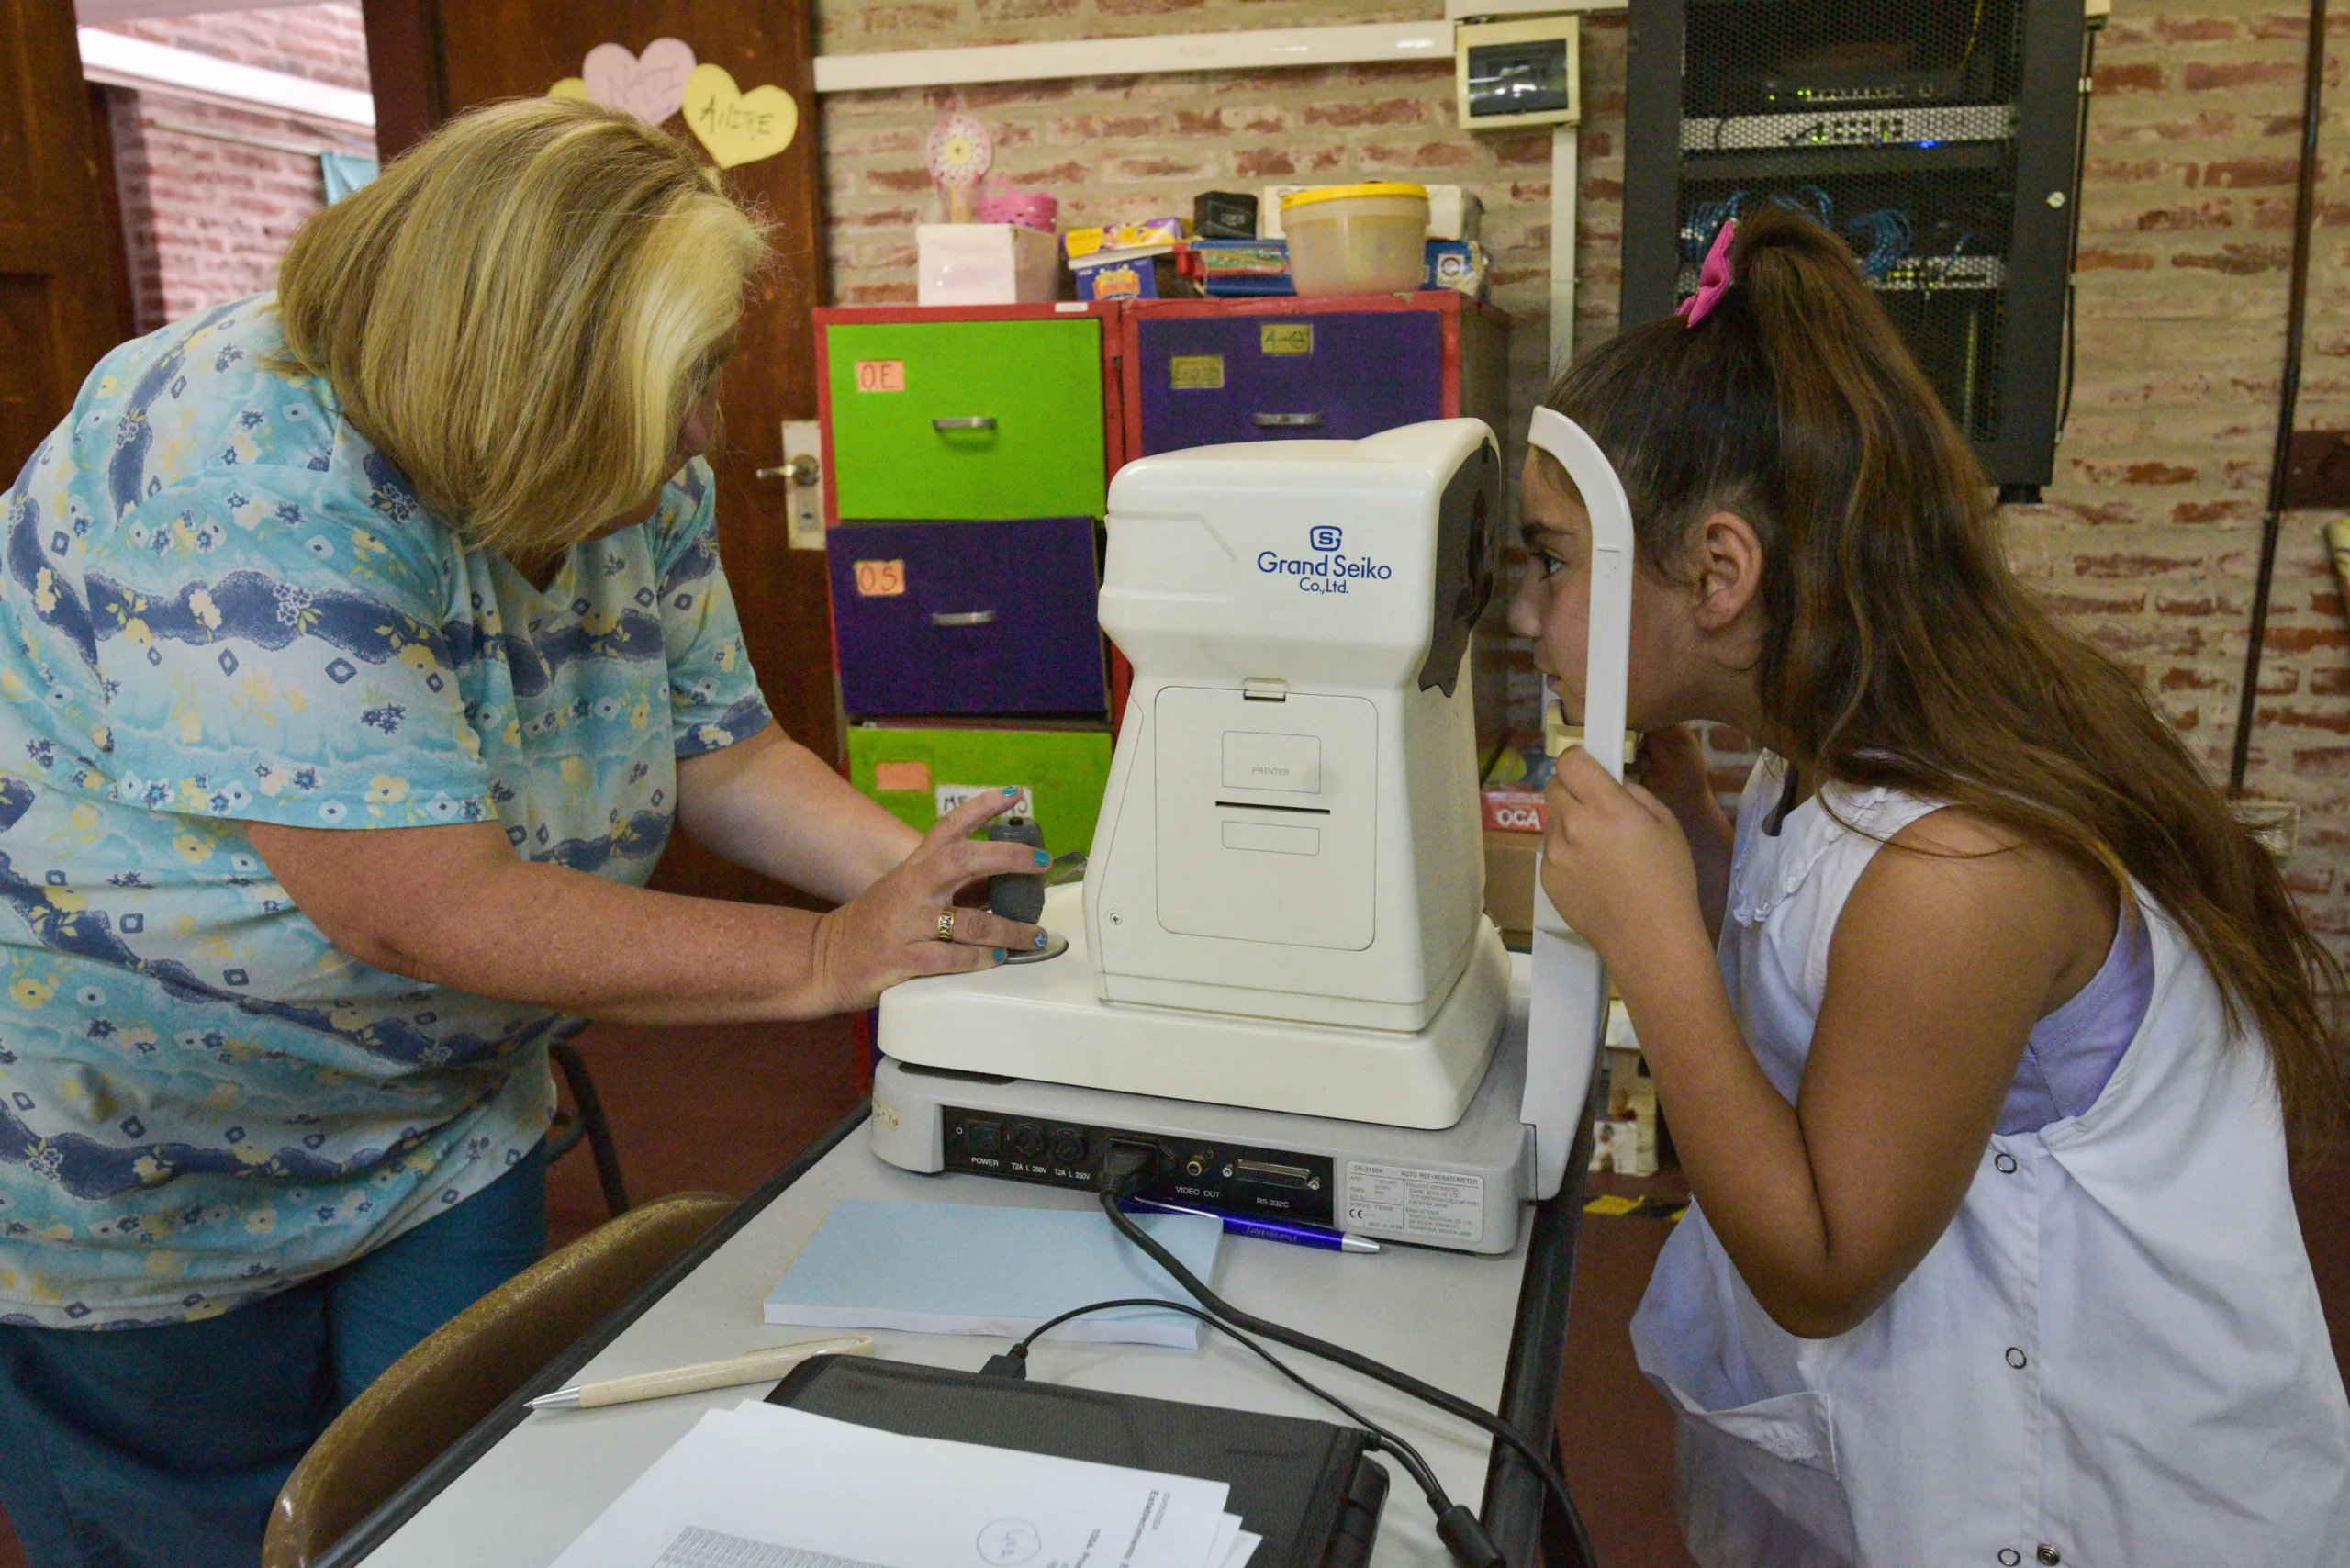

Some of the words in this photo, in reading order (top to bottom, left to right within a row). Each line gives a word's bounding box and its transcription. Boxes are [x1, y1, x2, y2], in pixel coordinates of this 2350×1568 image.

[1257, 551, 1329, 577] Grand
[1332, 554, 1393, 580] Seiko
[1251, 767, 1290, 777] PRINTER
[971, 1157, 999, 1167] POWER
[1032, 1166, 1047, 1174] 250V
[1401, 1170, 1417, 1179] AUTO
[1075, 1171, 1091, 1181] 250V
[1175, 1186, 1201, 1196] VIDEO
[1203, 1190, 1221, 1199] OUT
[1256, 1197, 1290, 1208] RS-232C
